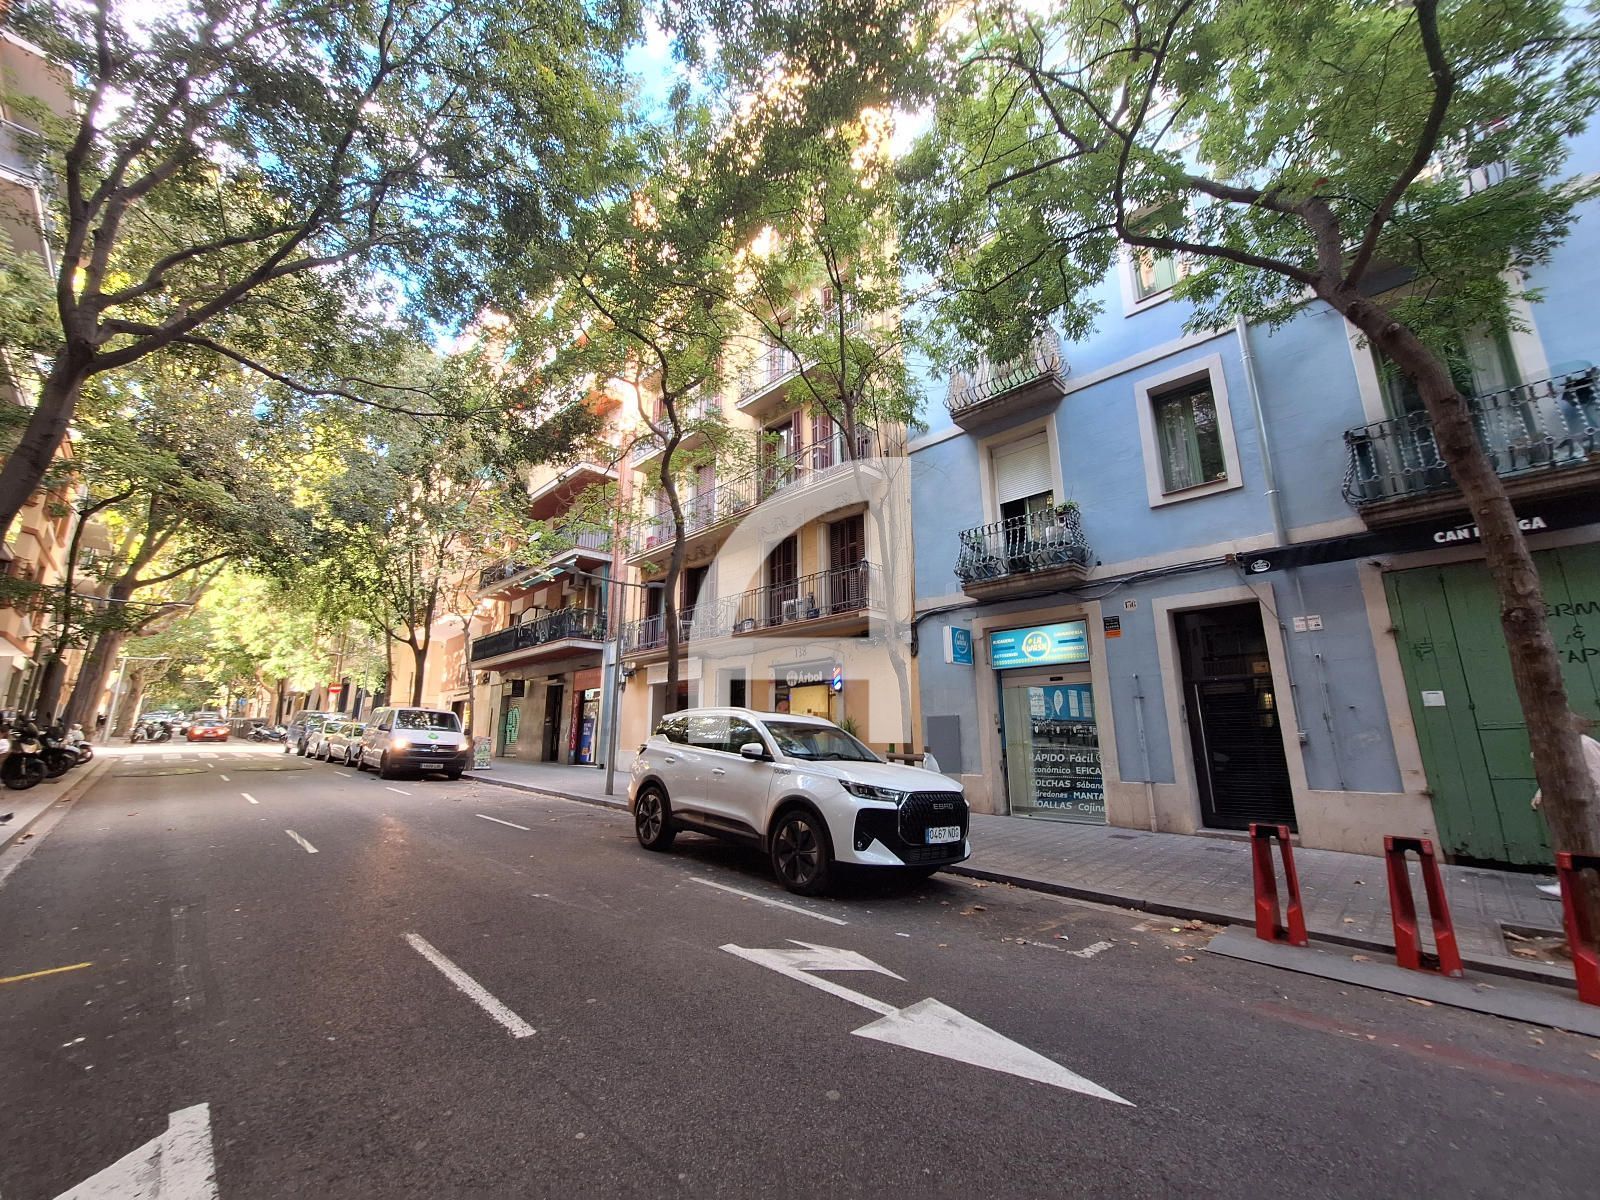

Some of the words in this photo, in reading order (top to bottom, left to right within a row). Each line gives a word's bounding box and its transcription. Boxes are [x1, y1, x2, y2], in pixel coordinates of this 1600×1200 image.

[1433, 527, 1470, 543] CAN
[798, 670, 823, 683] Árbol
[1069, 752, 1094, 763] Fácil
[930, 828, 946, 840] 0467
